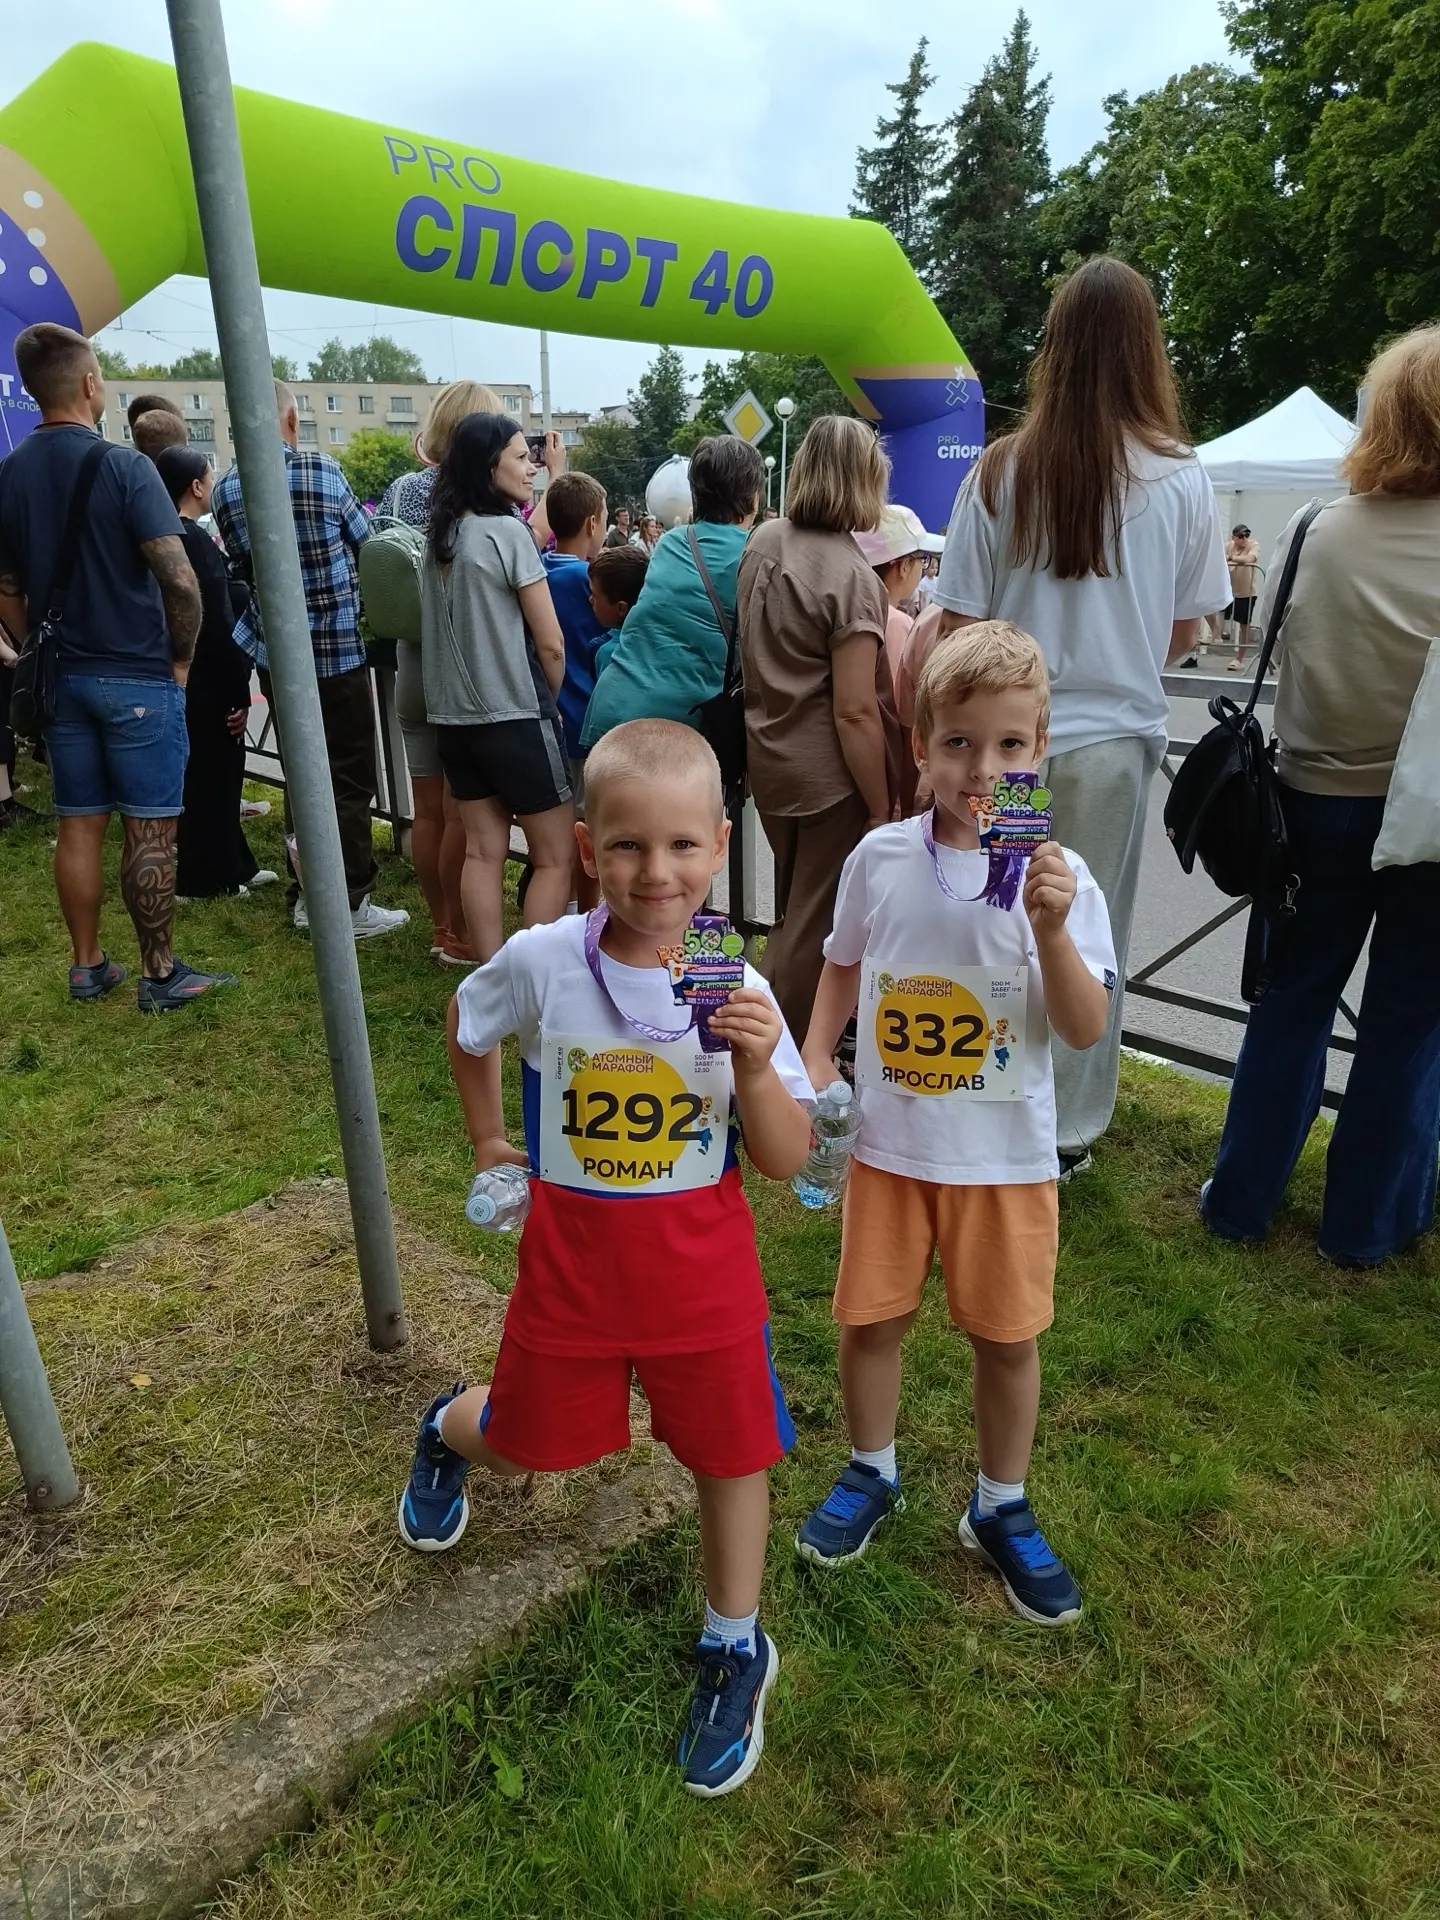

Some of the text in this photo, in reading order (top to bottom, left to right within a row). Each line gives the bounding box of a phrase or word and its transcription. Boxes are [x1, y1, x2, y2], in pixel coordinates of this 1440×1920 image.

[384, 136, 501, 195] PRO
[396, 195, 774, 319] СПОРТ 40
[16, 400, 41, 413] СПОР
[937, 435, 960, 444] PRO
[897, 978, 952, 988] АТОМНЫЙ
[897, 987, 952, 997] МАРАФОН
[883, 1009, 984, 1057] 332
[592, 1053, 654, 1064] АТОМНЫЙ
[592, 1063, 654, 1073] МАРАФОН
[882, 1066, 985, 1091] ЯРОСЛАВ
[561, 1089, 703, 1143] 1292
[583, 1157, 673, 1179] РОМАН
